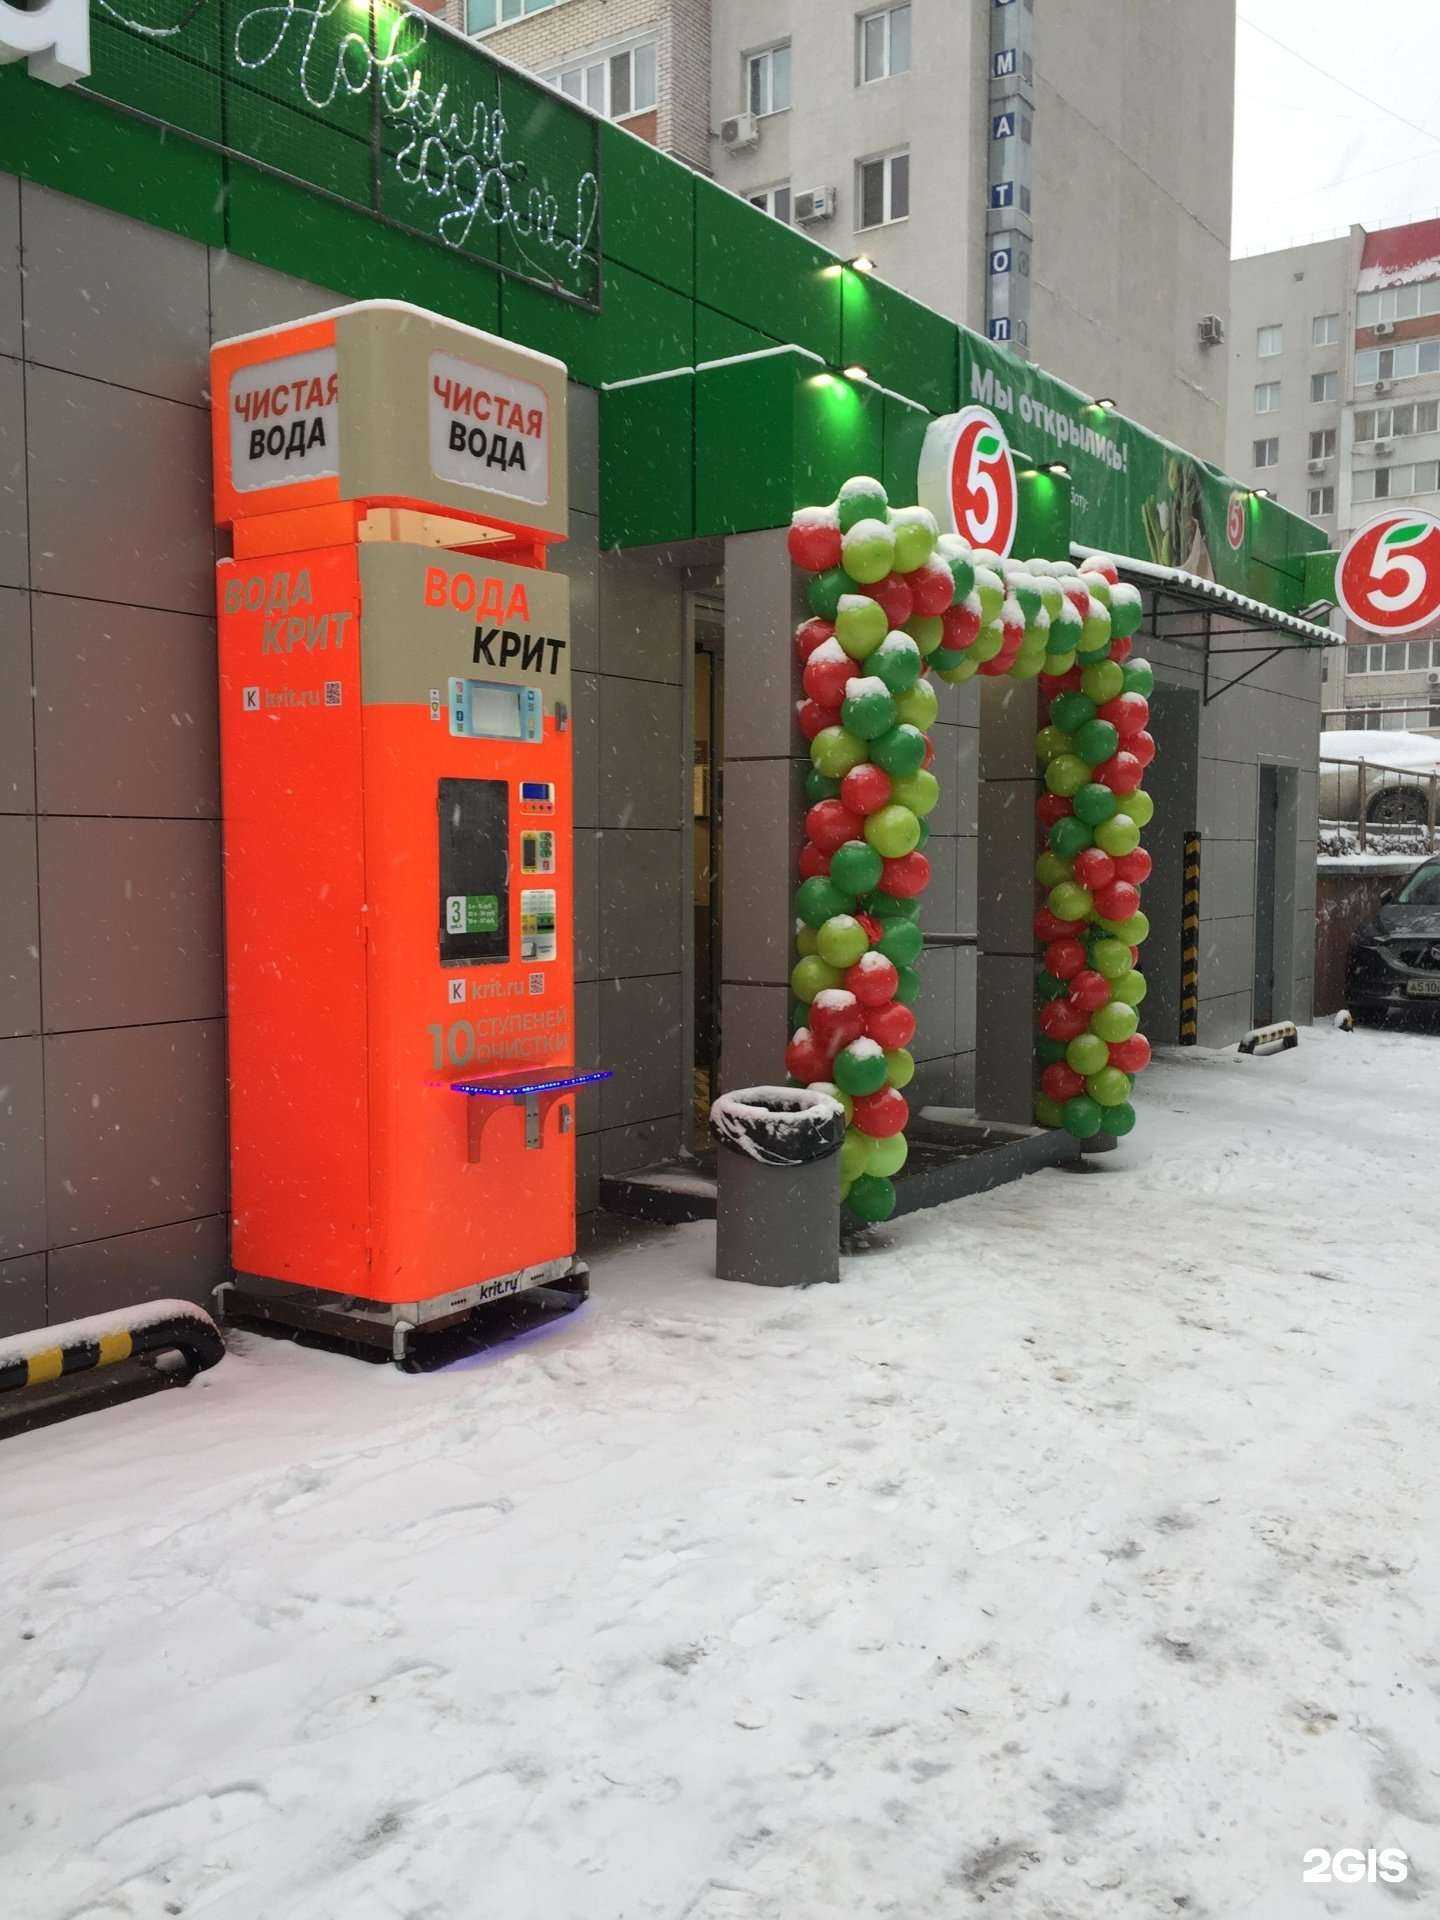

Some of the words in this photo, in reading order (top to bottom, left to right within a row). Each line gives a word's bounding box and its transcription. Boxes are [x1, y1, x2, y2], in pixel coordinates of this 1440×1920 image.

[993, 0, 1015, 340] МАТОЛ
[235, 372, 338, 423] ЧИСТАЯ
[433, 375, 543, 439] ЧИСТАЯ
[971, 361, 1014, 415] Мы
[1019, 395, 1128, 474] открылись!
[249, 417, 326, 461] ВОДА
[449, 420, 526, 472] ВОДА
[964, 426, 1001, 544] 5
[224, 568, 313, 615] ВОДА
[1366, 521, 1432, 612] 5
[424, 566, 530, 627] ВОДА
[262, 612, 352, 655] КРИТ
[472, 626, 566, 676] КРИТ
[452, 901, 461, 923] 3
[472, 980, 524, 1000] krit.ru
[427, 1019, 475, 1070] 10
[476, 1006, 567, 1039] СТУПЕНЕЙ
